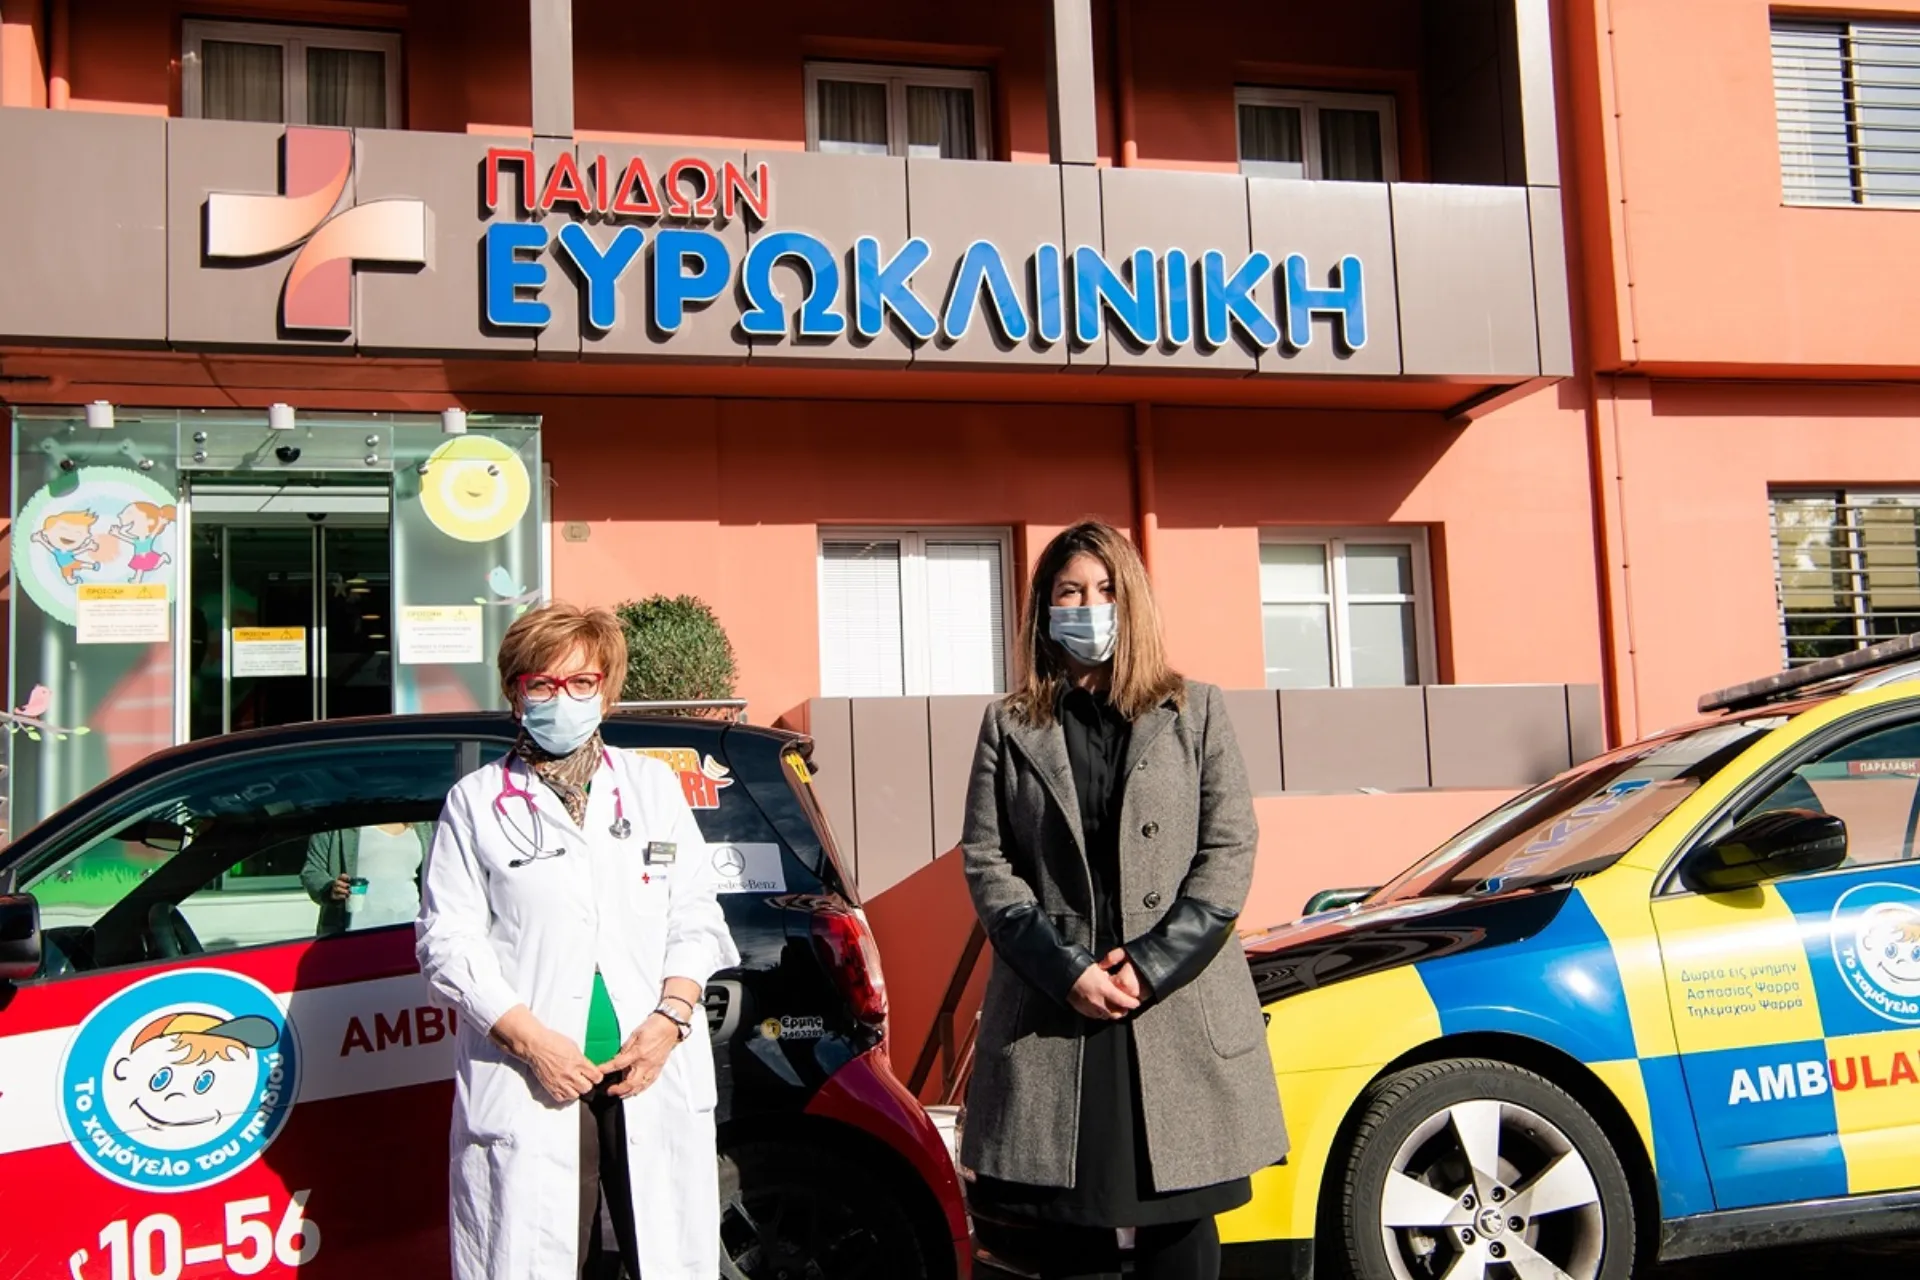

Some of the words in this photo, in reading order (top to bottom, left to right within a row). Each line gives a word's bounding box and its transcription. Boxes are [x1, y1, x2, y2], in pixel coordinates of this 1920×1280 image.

[485, 147, 770, 221] ΠΑΙΔΩΝ
[485, 222, 1369, 352] ΕΥΡΩΚΛΙΝΙΚΗ
[716, 879, 777, 890] edes-Benz
[74, 1076, 95, 1113] Το
[239, 1052, 284, 1143] παιδιού
[1728, 1050, 1920, 1106] AMBULA
[82, 1115, 191, 1177] χαμόγελο
[195, 1138, 241, 1171] του
